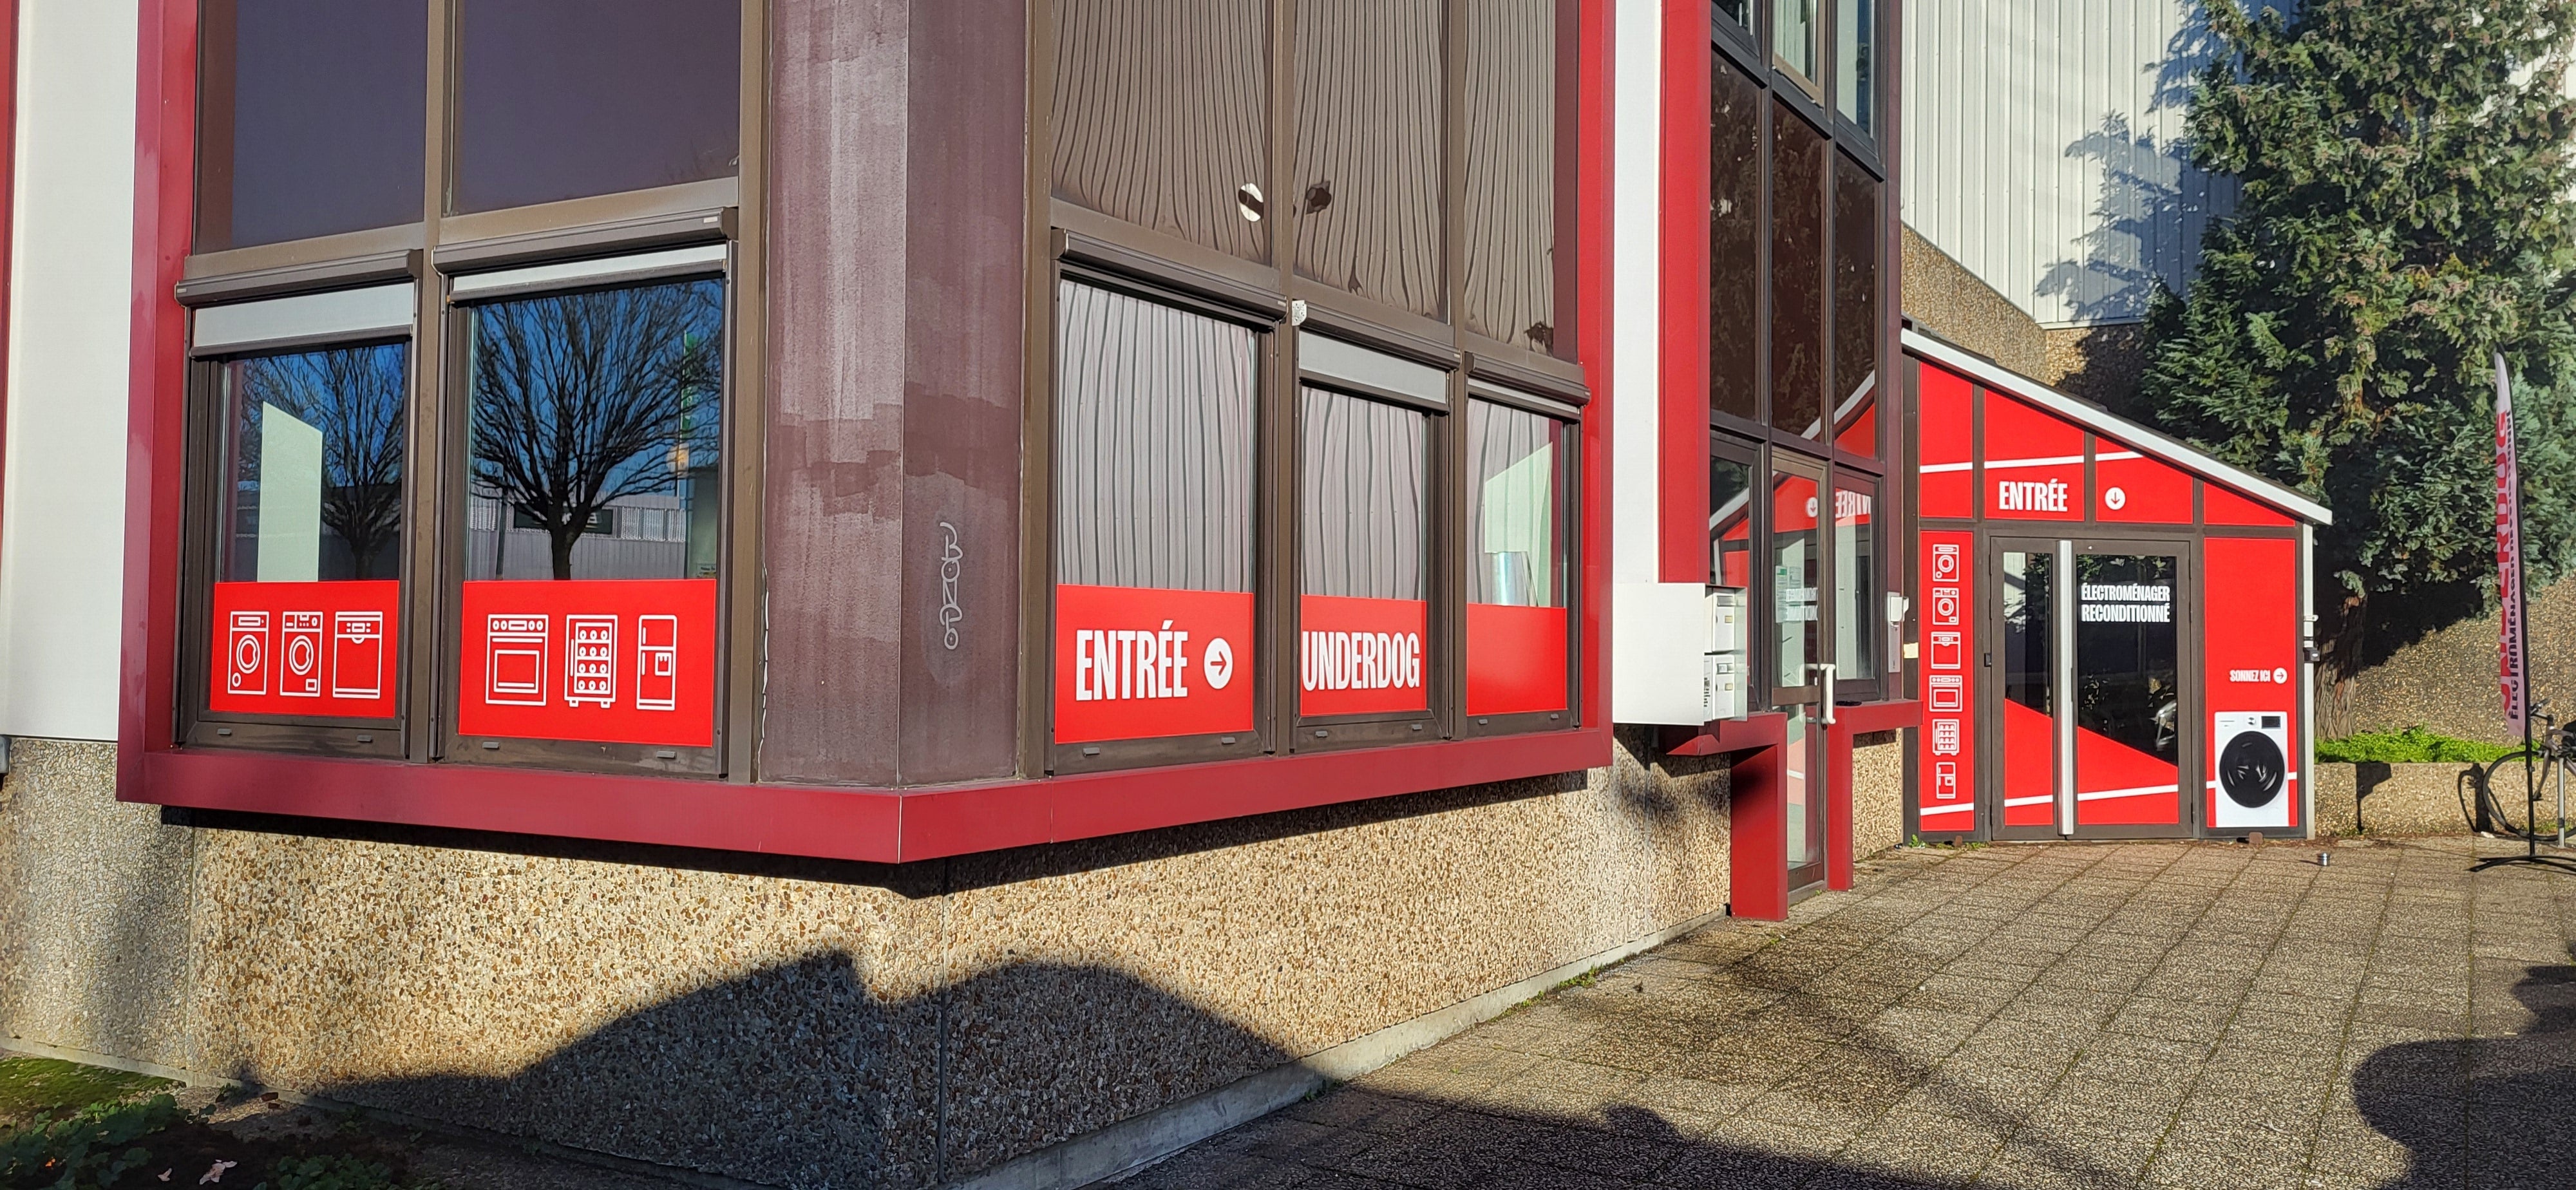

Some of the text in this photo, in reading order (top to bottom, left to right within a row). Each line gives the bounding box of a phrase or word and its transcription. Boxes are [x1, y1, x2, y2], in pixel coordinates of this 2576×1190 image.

[2000, 478, 2067, 511] ENTRÉE
[2081, 583, 2170, 601] ÉLECTROMÉNAGER
[2081, 603, 2170, 622] RECONDITIONNÉ
[1076, 620, 1188, 701] ENTRÉE
[1302, 631, 1419, 690] UNDERDOG
[2230, 670, 2270, 681] SONNEZ ICI
